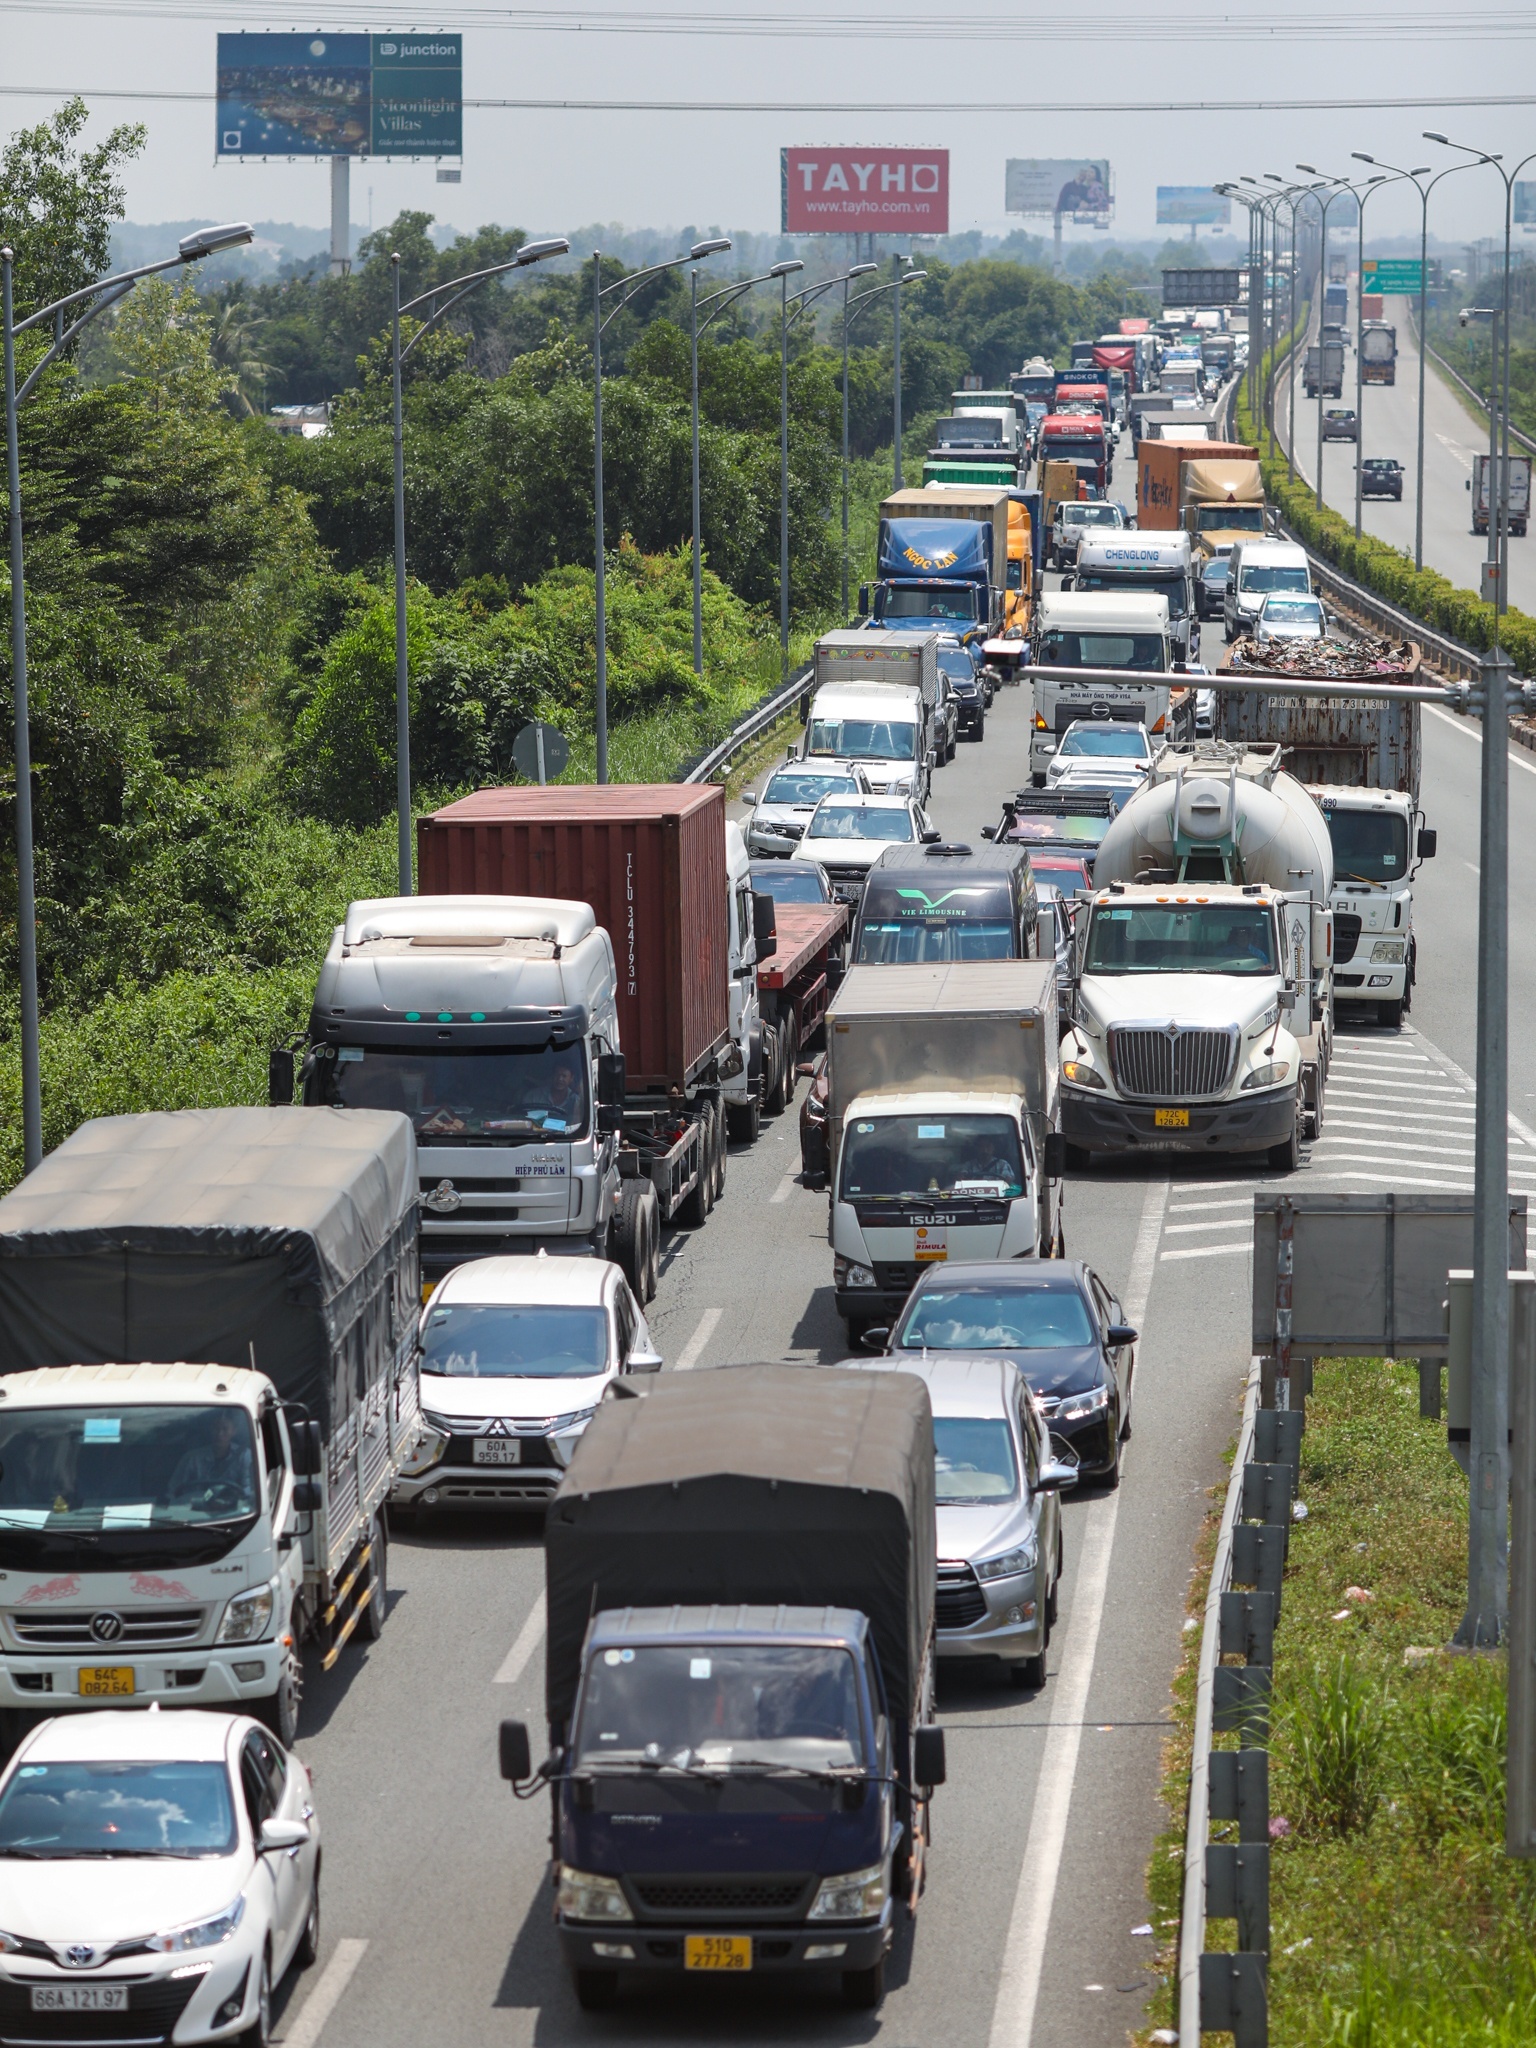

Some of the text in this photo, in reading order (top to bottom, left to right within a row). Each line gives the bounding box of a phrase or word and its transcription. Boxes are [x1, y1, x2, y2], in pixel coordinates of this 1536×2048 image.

[400, 43, 456, 58] junction
[380, 97, 456, 117] Moonlight
[380, 115, 422, 130] Villas
[797, 163, 939, 192] TAYHO
[806, 200, 930, 214] www.tayho.com.vn
[934, 551, 959, 570] LAN
[1105, 549, 1159, 561] CHENGLONG
[626, 853, 634, 901] TCLU
[627, 905, 635, 977] 344793
[1165, 1110, 1180, 1118] 72C
[1160, 1118, 1185, 1126] 128.24
[515, 1163, 532, 1177] HIỆP
[550, 1164, 565, 1175] LÂM
[910, 1215, 956, 1225] ISUZU
[486, 1441, 507, 1451] 60A
[478, 1452, 515, 1462] 959.17
[94, 1668, 118, 1681] 64C
[85, 1681, 128, 1694] 082.64
[693, 1953, 744, 1968] 277.28
